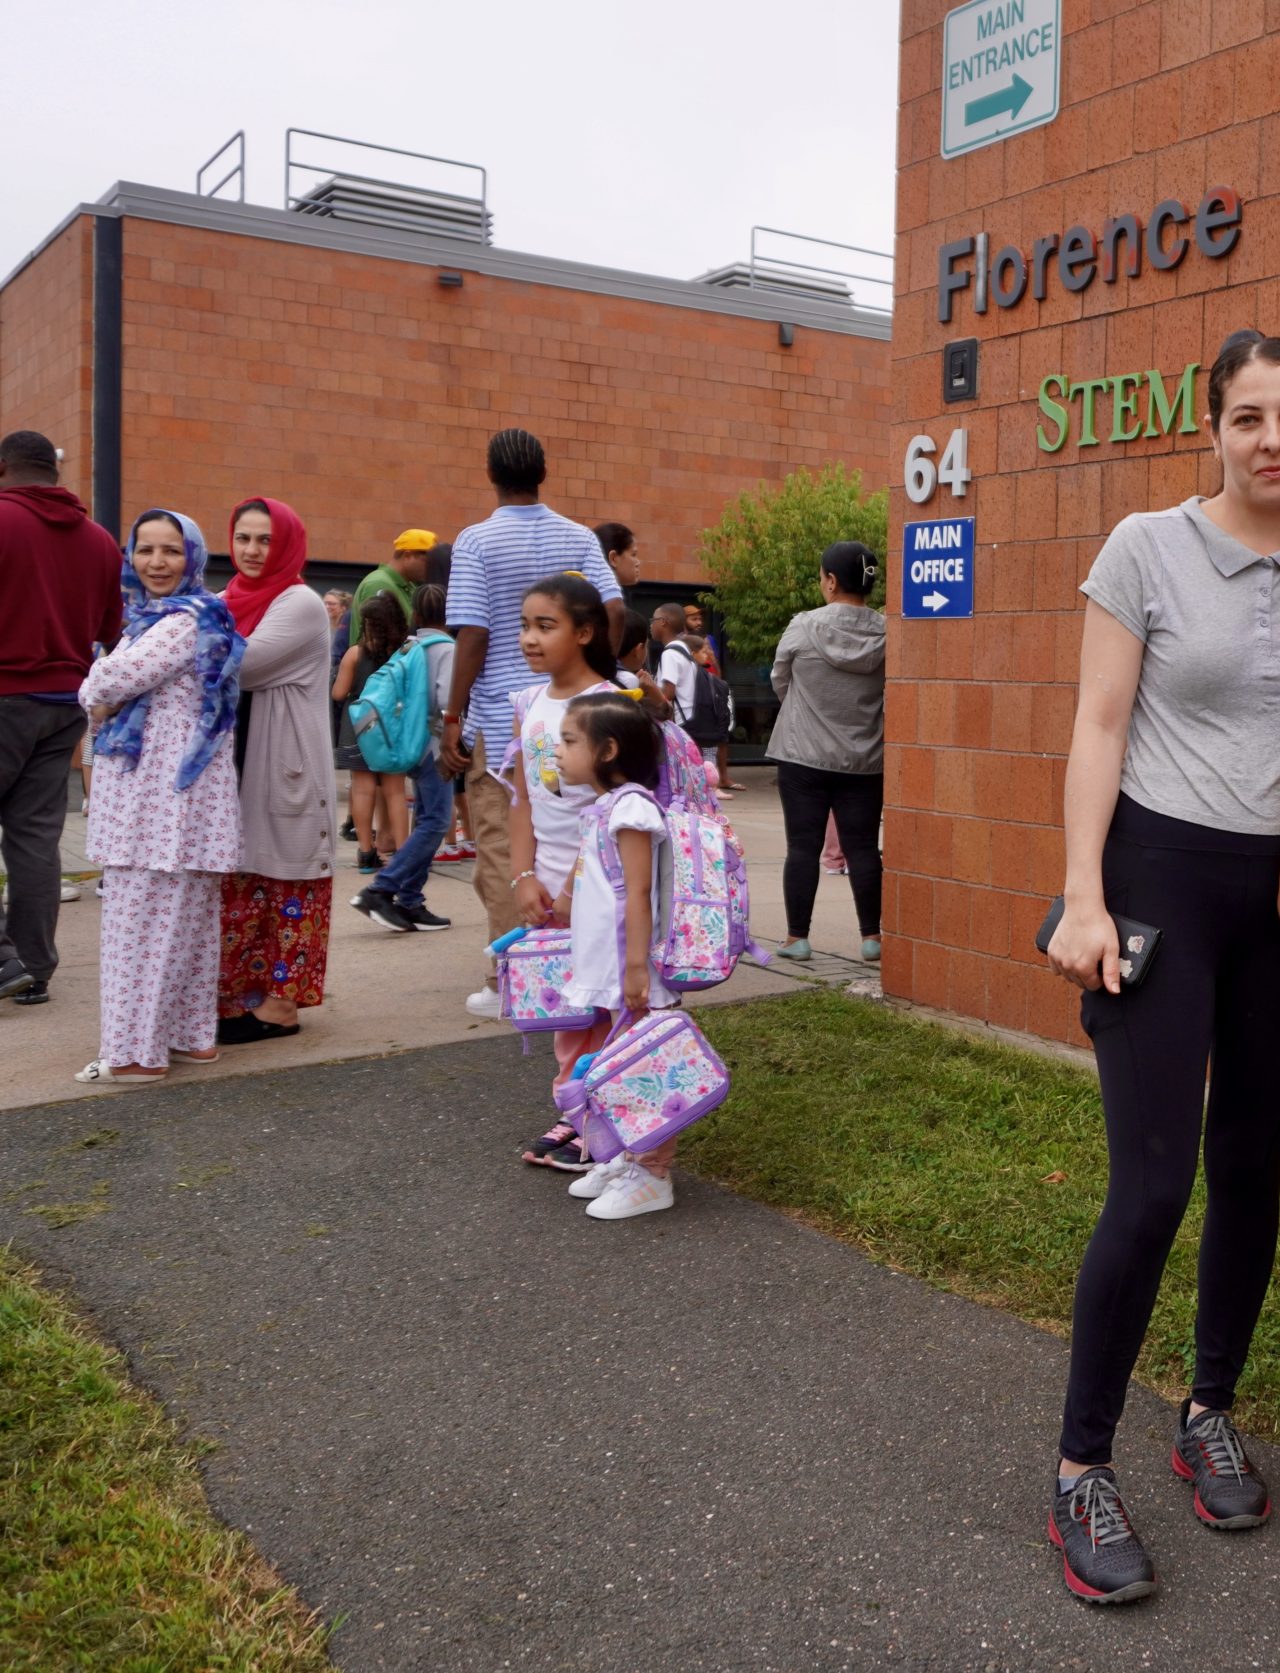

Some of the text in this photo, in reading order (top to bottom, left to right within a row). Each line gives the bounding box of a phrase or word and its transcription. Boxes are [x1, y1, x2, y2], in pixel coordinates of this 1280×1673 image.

[976, 0, 1025, 41] MAIN
[949, 22, 1053, 90] ENTRANCE
[938, 184, 1242, 324] Florence
[1036, 363, 1201, 453] STEM
[904, 428, 971, 504] 64
[910, 558, 964, 584] OFFICE
[914, 525, 962, 550] MAIN
